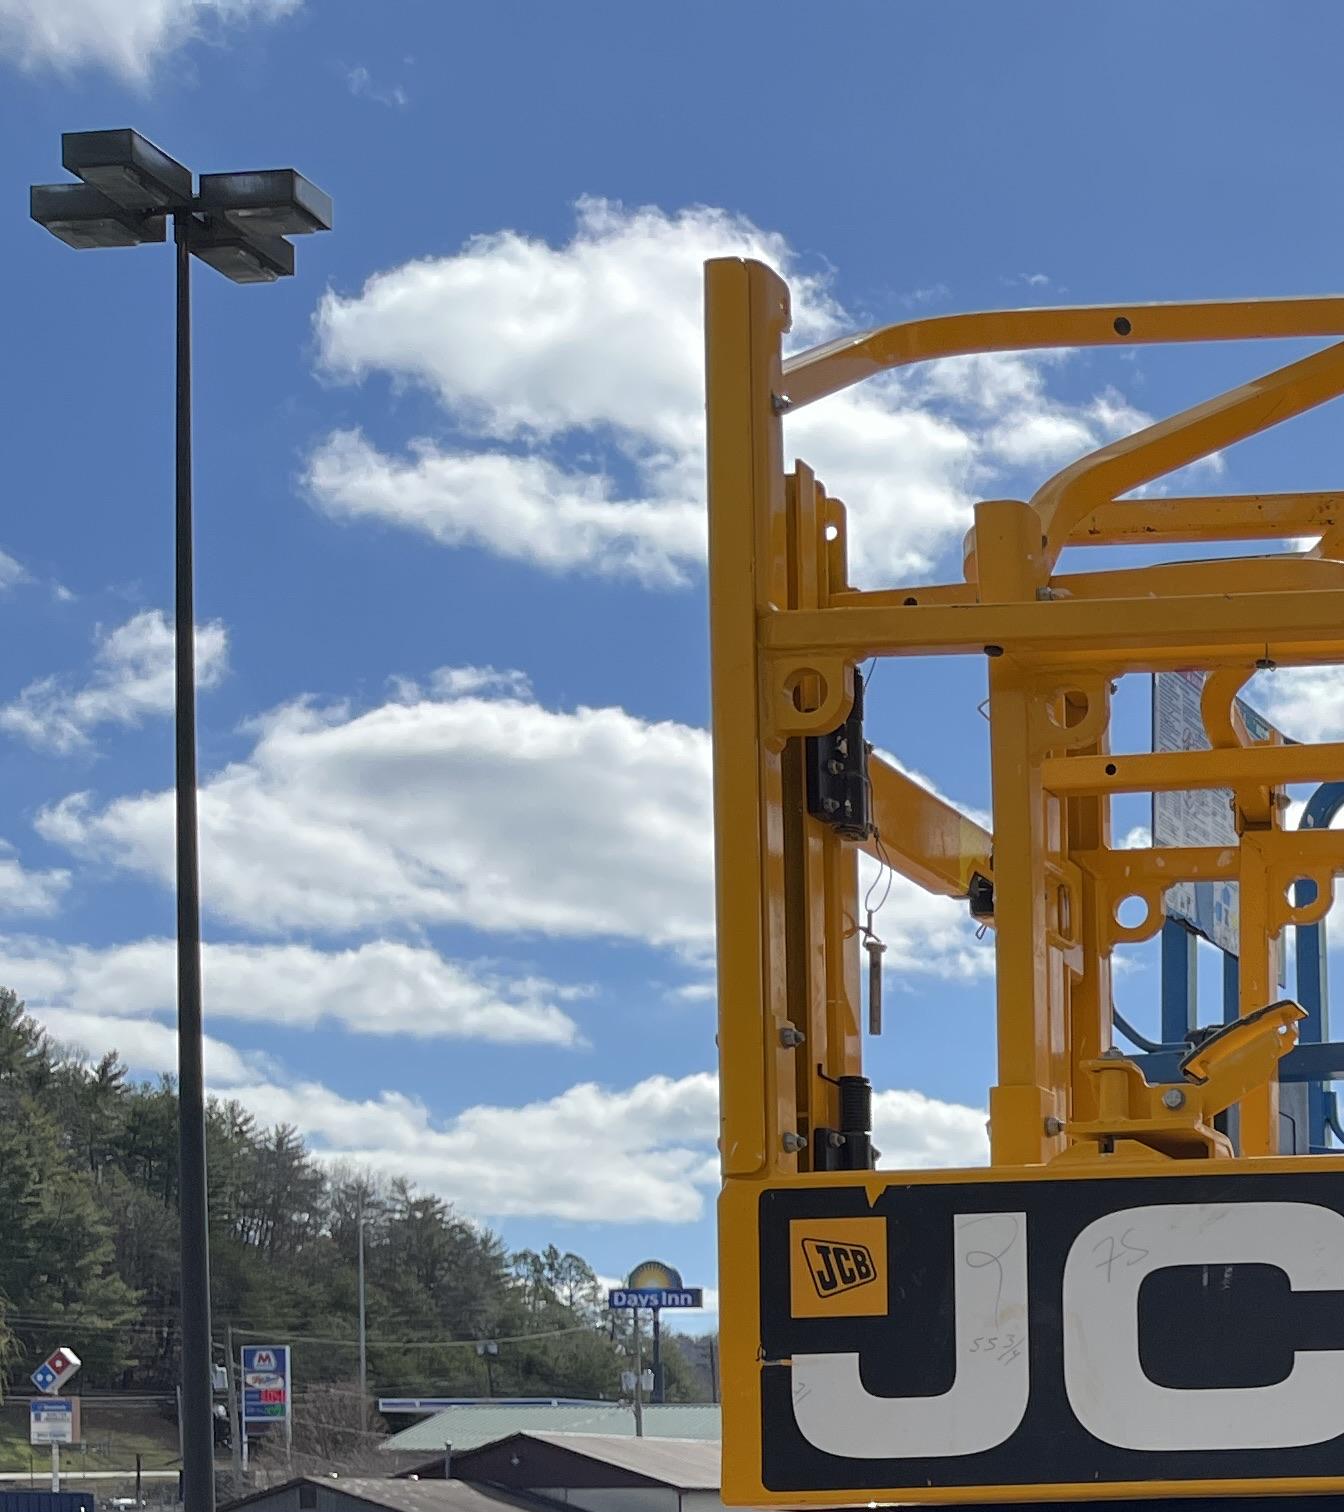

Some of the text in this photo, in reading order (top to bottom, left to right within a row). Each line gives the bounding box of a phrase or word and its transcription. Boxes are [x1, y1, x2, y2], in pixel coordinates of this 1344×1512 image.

[815, 1245, 872, 1291] JCB
[613, 1291, 694, 1307] Days Inn
